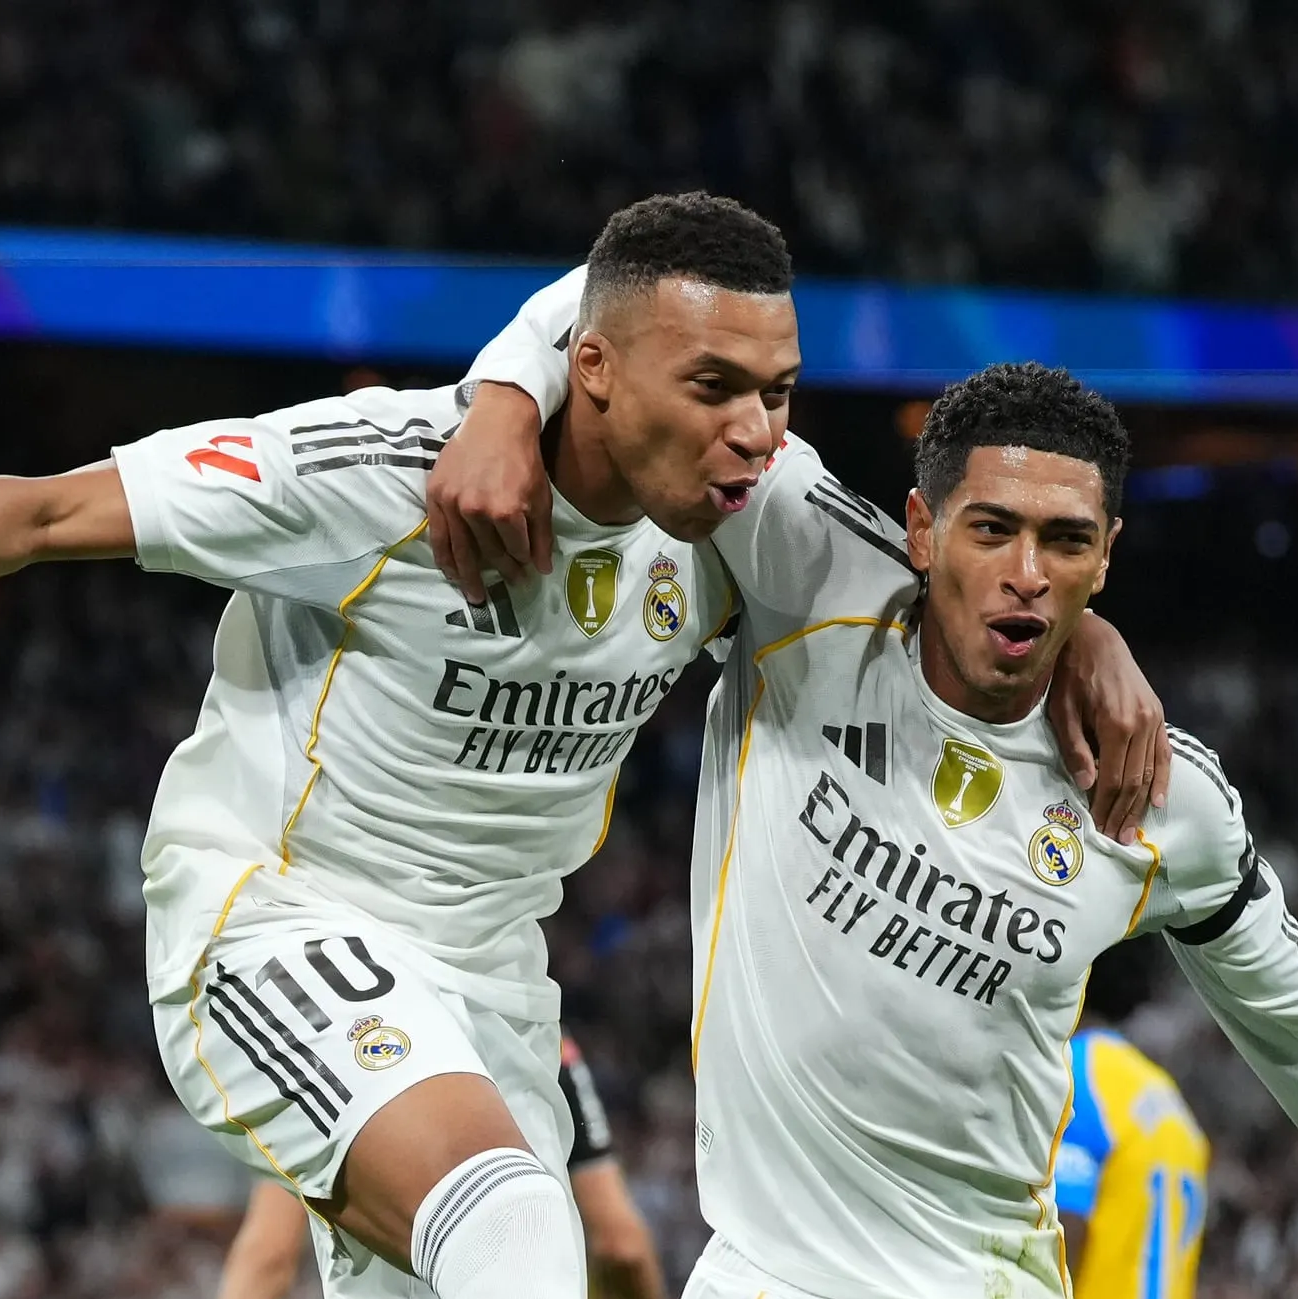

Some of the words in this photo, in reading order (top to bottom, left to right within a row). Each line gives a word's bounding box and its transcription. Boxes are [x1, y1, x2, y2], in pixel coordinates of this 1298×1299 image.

[432, 658, 675, 726] Emirates
[454, 727, 525, 773] FLY
[523, 727, 636, 774] BETTER
[799, 770, 1066, 964] Emirates
[255, 936, 396, 1033] 10
[806, 867, 878, 934] FLY
[868, 913, 1012, 1005] BETTER
